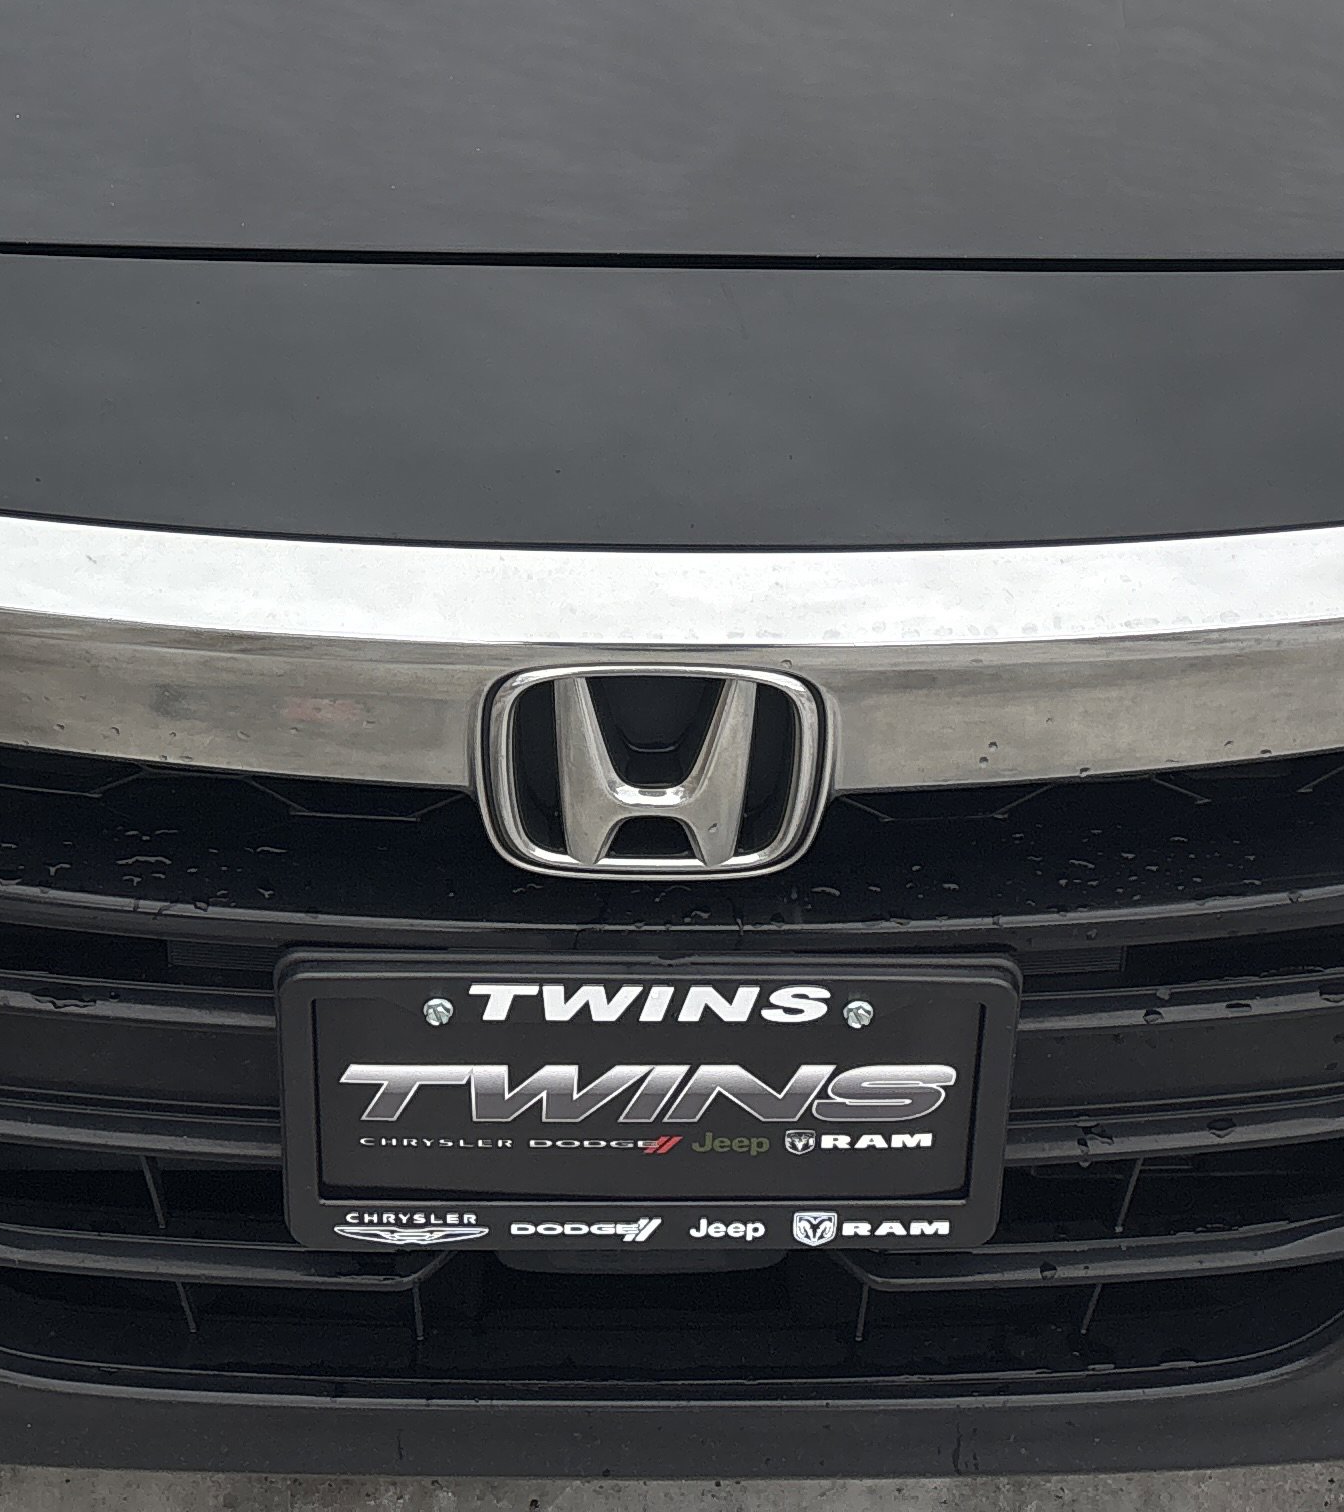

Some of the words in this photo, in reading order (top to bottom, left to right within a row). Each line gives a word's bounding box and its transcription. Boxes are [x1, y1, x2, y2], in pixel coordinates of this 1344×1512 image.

[468, 983, 832, 1023] TWINS
[339, 1064, 957, 1123] TWINS
[359, 1137, 514, 1149] CHRYSLER
[528, 1138, 660, 1150] DODGE
[691, 1132, 770, 1155] Jeep
[820, 1133, 933, 1150] RAM
[345, 1211, 478, 1225] CHRYSLER
[510, 1223, 640, 1235] DODGE
[689, 1218, 766, 1241] Jeep
[841, 1220, 950, 1236] RAM
